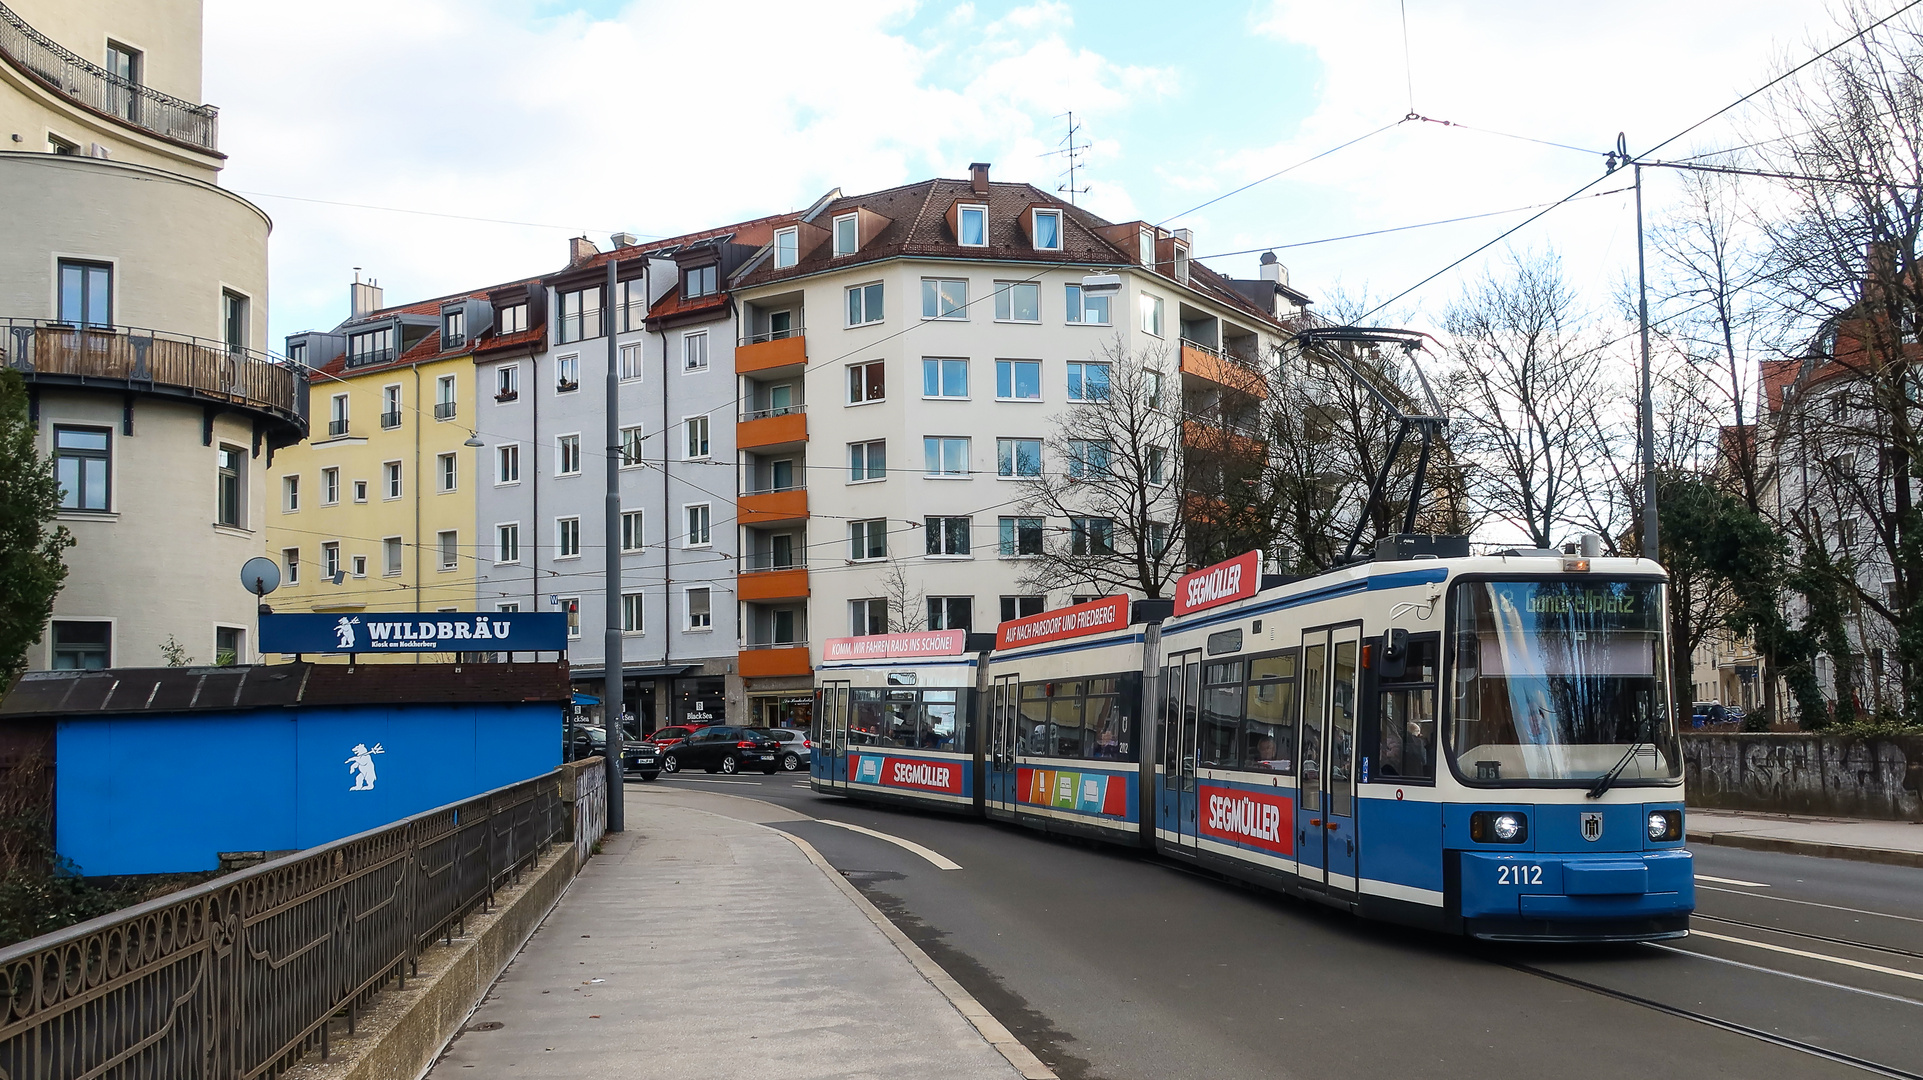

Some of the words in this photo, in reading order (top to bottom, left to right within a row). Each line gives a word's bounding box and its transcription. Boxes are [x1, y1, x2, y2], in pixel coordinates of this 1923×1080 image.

[1186, 563, 1241, 608] SEGMÜLLER
[367, 616, 511, 640] WILDBRÄU
[1005, 627, 1016, 643] AUF
[1016, 624, 1032, 640] NACH
[1032, 616, 1062, 637] PARSDORF
[1062, 613, 1077, 632] UND
[1077, 605, 1116, 628] FRIEDBERG!
[371, 640, 388, 648] Kiosk
[400, 640, 437, 649] Nockherberg
[831, 642, 852, 656] KOMM,
[853, 641, 866, 654] WIR
[866, 640, 889, 653] FAHREN
[891, 639, 908, 652] RAUS
[909, 638, 920, 651] INS
[921, 634, 953, 651] SCHÖNE!
[893, 762, 950, 788] SEGMÜLLER
[1209, 794, 1280, 843] SEGMÜLLER
[1497, 865, 1543, 885] 2112
